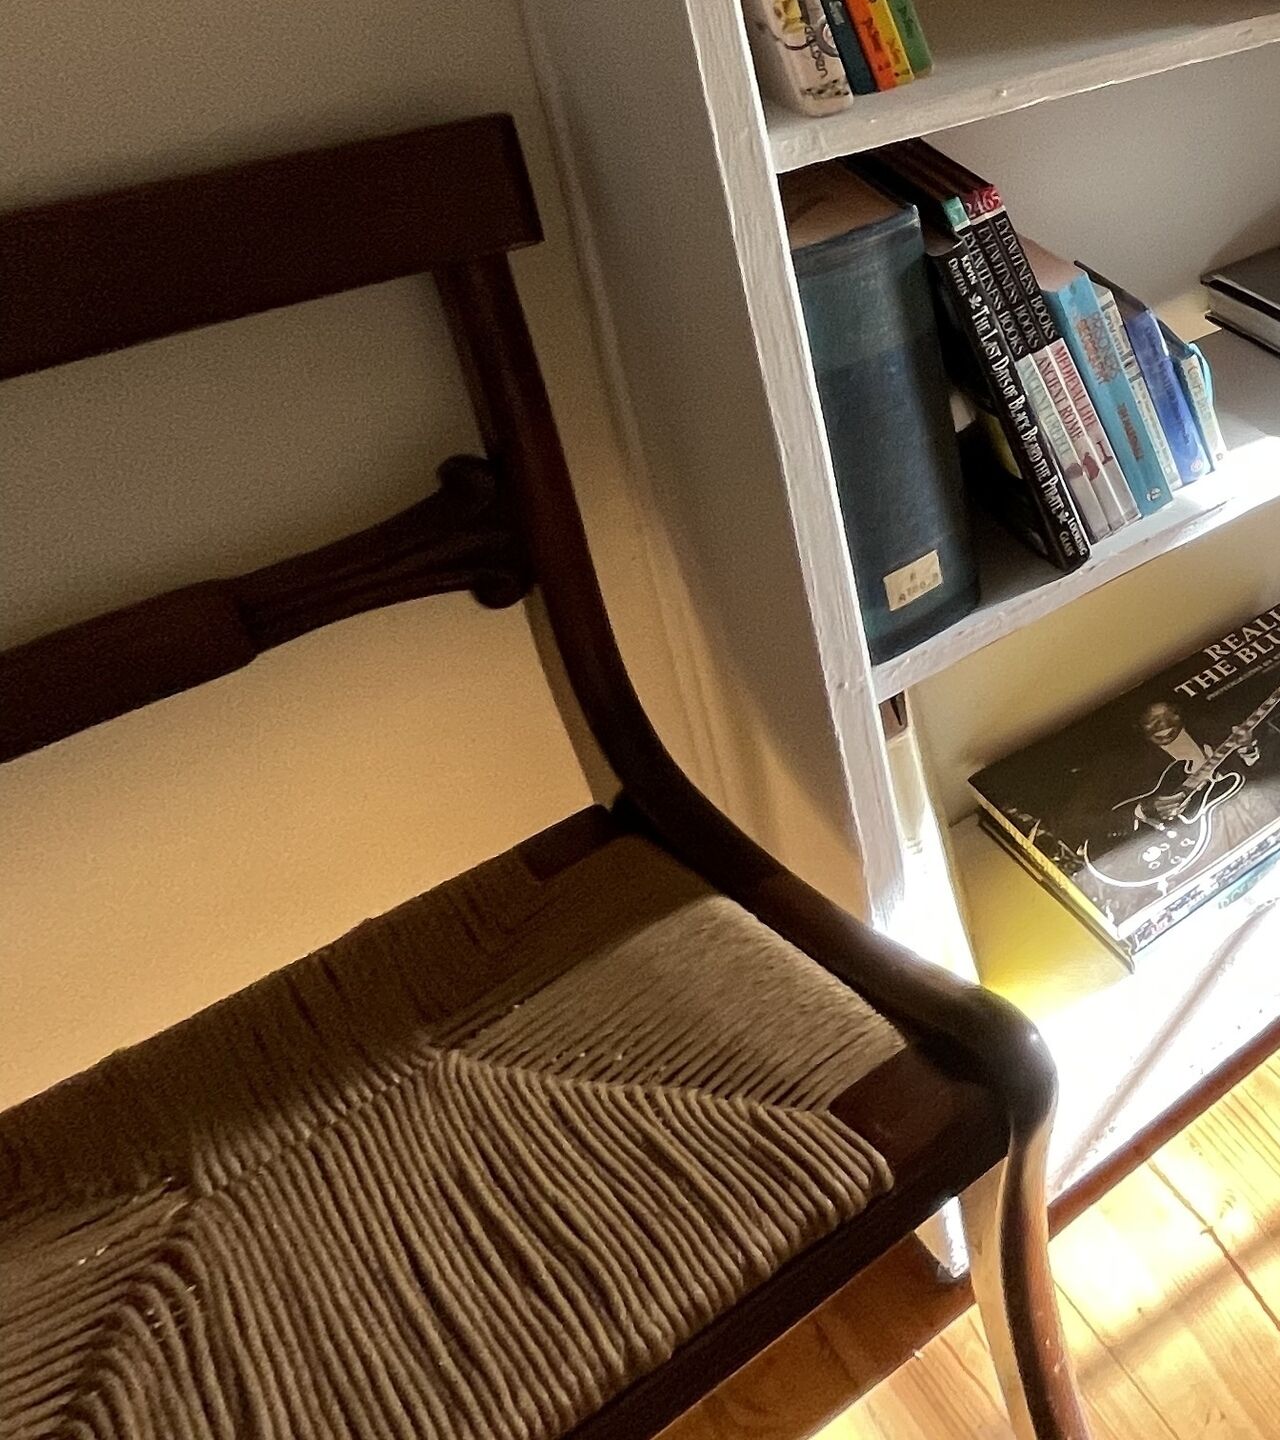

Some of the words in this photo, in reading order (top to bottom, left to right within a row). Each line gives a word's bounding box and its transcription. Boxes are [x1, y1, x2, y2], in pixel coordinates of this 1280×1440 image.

[960, 254, 979, 286] KEVIN
[978, 225, 1019, 304] EYEWITNESS
[1015, 304, 1041, 349] BOOKS
[995, 217, 1035, 296] EYEWITNESS
[1031, 295, 1056, 340] BOOKS
[963, 231, 1006, 311] EYEWITNESS
[999, 310, 1025, 356] BOOKS
[972, 305, 992, 335] THE
[981, 329, 1002, 360] LAST
[992, 355, 1015, 389] DAYS
[1055, 344, 1087, 402] MEDIEVAL
[1077, 402, 1098, 429] LIFE
[1003, 385, 1019, 398] OF
[1037, 356, 1068, 405] ANCIENT
[1059, 405, 1085, 441] ROME
[1008, 394, 1033, 432] BLACK
[1021, 425, 1044, 464] BEARD
[1032, 458, 1050, 482] THE
[1041, 474, 1065, 516] PIRATE
[1067, 517, 1089, 556] LOOKING
[1174, 659, 1238, 697] THE
